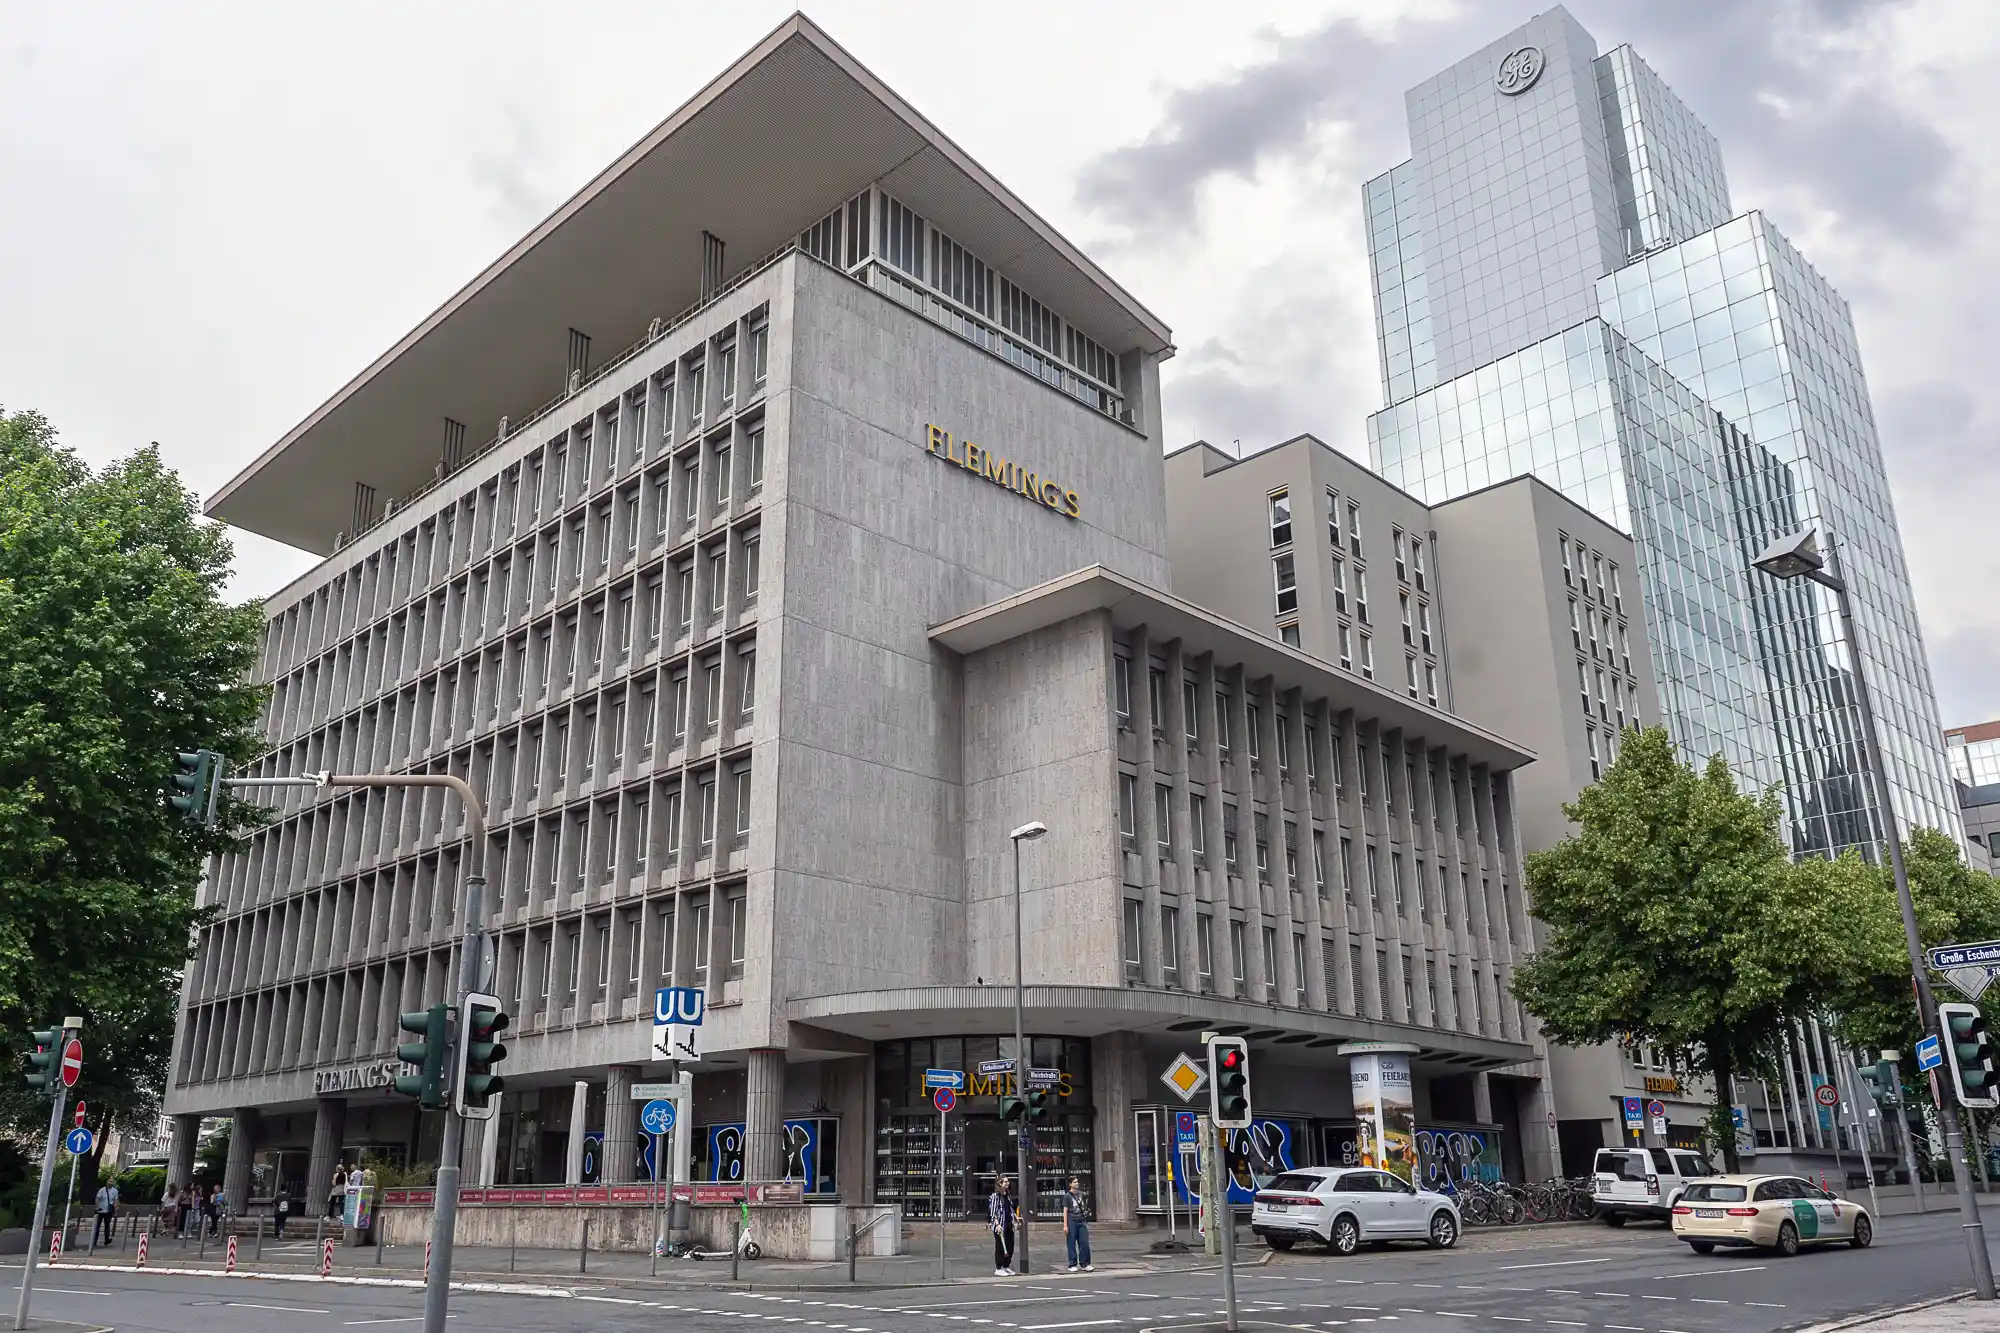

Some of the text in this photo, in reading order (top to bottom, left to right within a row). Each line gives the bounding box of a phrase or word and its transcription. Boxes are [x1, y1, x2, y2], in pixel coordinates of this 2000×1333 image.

[1940, 947, 2000, 964] Große Eschenh
[656, 990, 675, 1021] U
[677, 990, 702, 1021] U
[312, 1060, 395, 1094] FLEMING'S
[1821, 1091, 1835, 1101] 40
